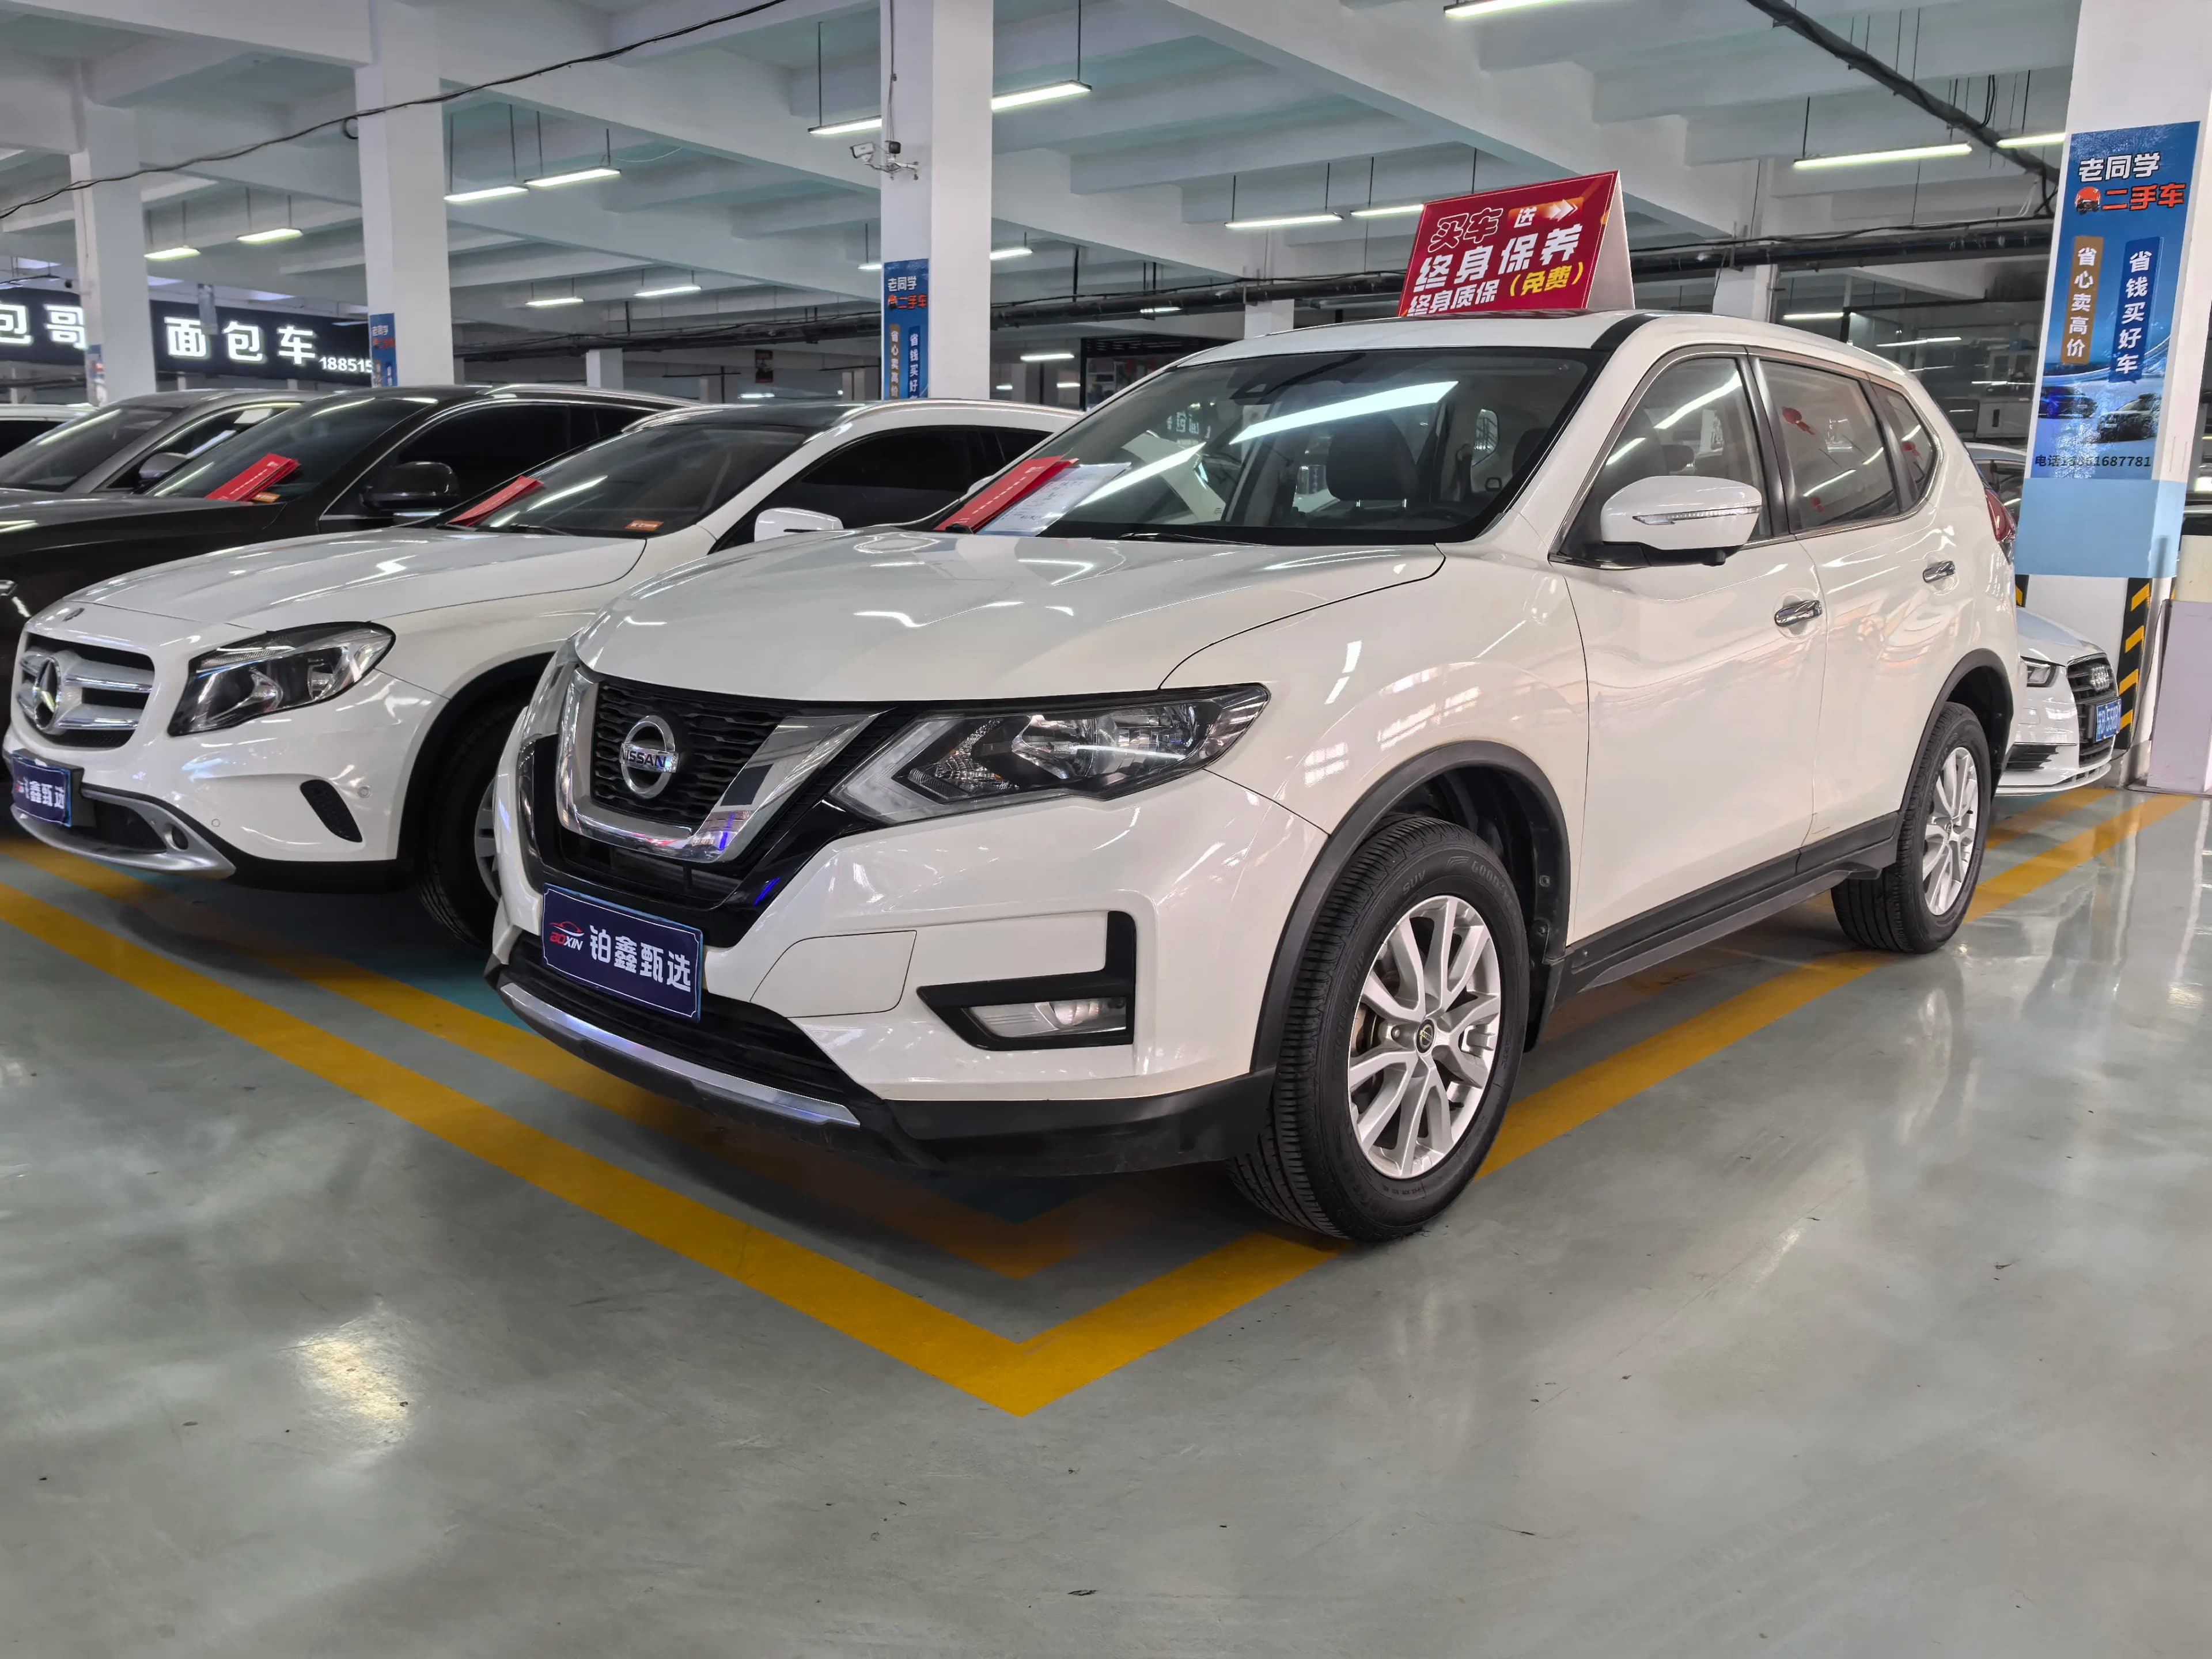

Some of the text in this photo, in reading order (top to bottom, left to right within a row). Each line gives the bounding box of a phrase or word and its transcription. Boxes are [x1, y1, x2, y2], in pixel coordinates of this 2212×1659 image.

[2078, 151, 2160, 183] 老同学
[2102, 183, 2187, 211] 二手车
[1427, 206, 1538, 253] 买车 送
[1412, 224, 1584, 293] 终身保养
[888, 275, 918, 292] 老同学
[1407, 279, 1501, 317] 终身质保
[2066, 247, 2098, 358] 省心卖高价
[2115, 249, 2153, 375] 省钱买好车
[164, 315, 317, 365] 面包车
[621, 749, 667, 769] NISSAN
[589, 925, 691, 993] 铂鑫甄选
